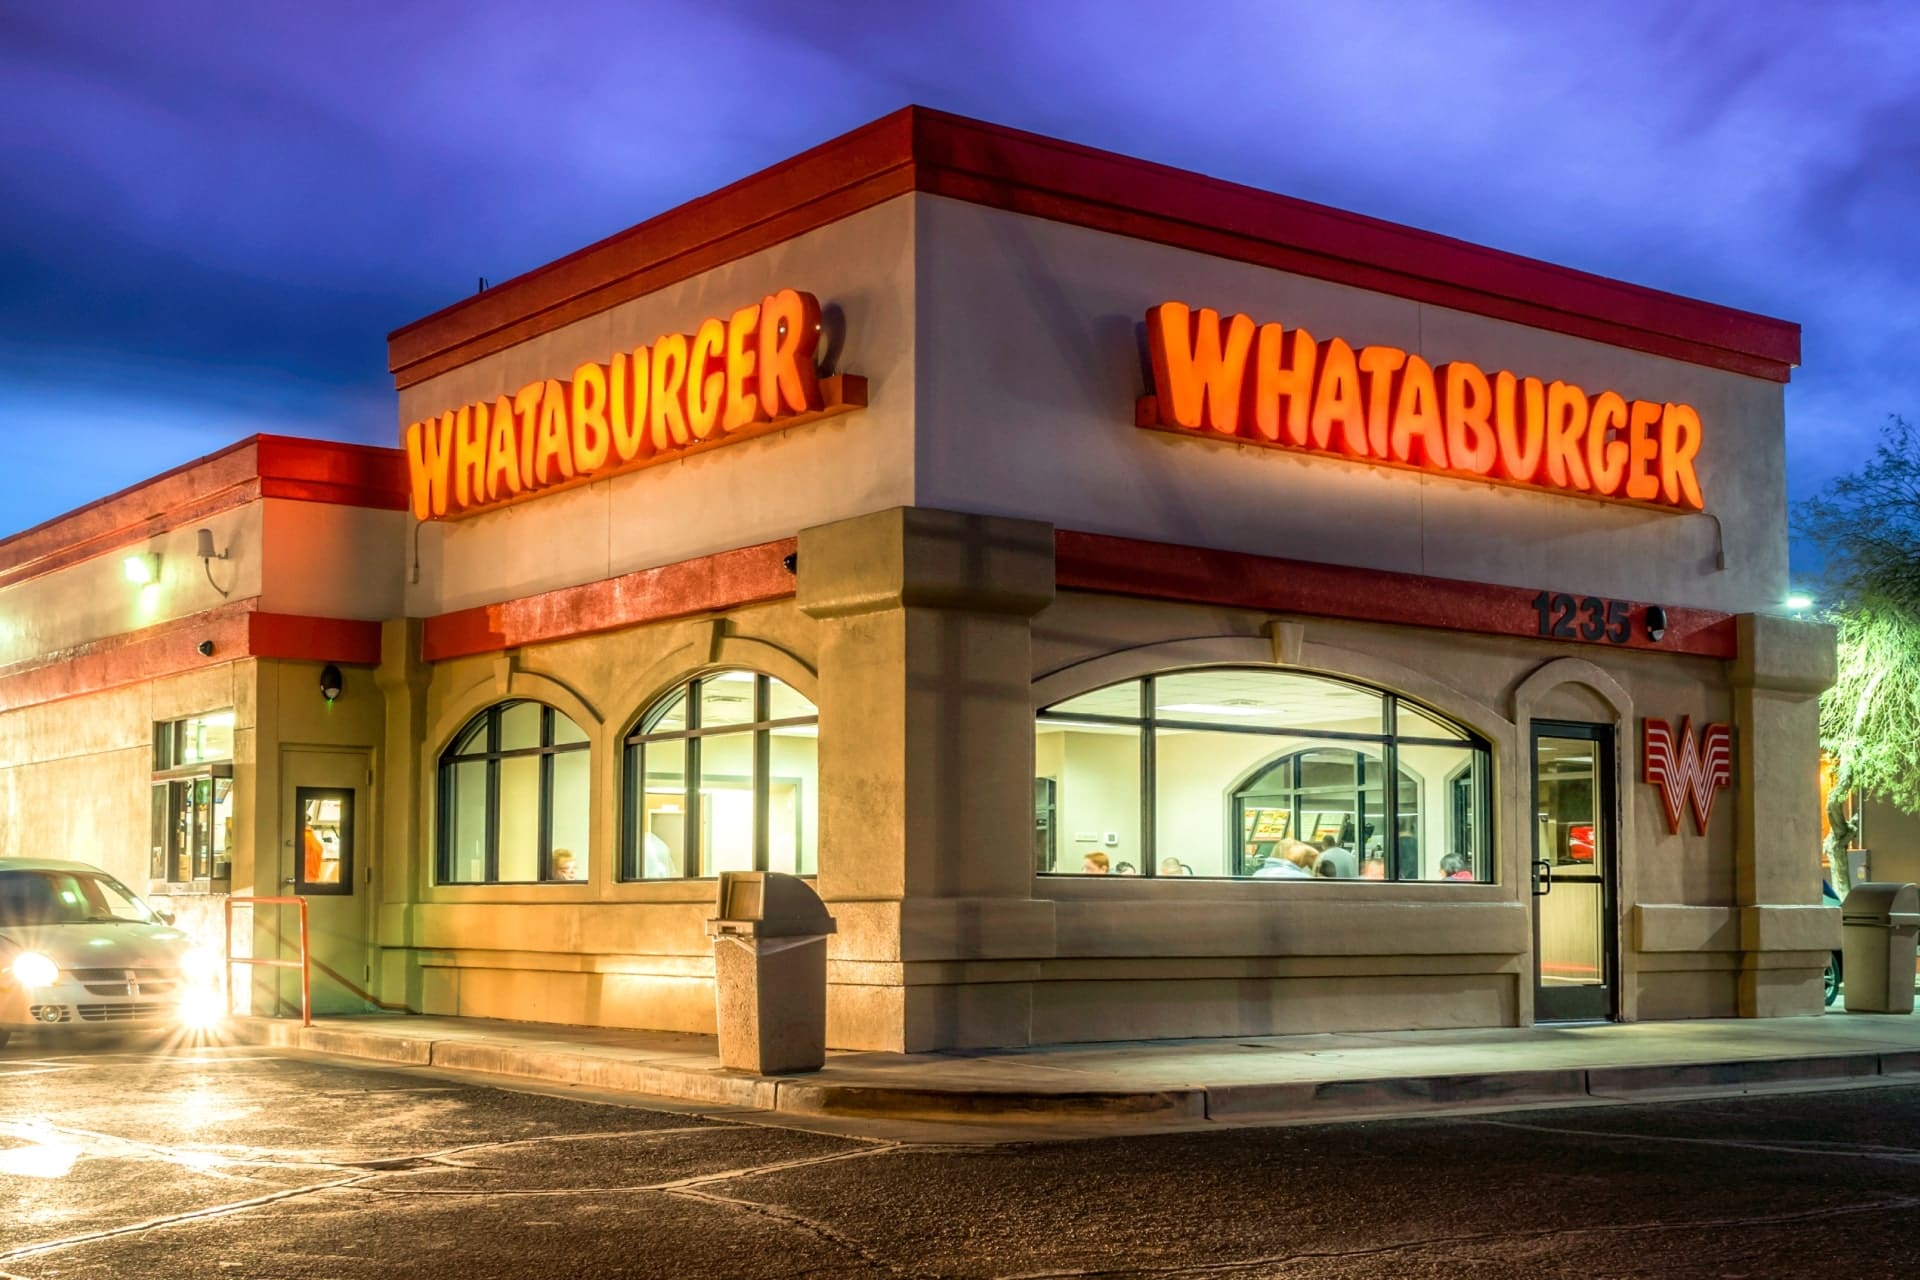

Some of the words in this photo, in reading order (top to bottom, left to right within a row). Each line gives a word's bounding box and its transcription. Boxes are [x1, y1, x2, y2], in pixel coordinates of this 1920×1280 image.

[406, 288, 815, 521] WHATABURGER
[1152, 301, 1704, 510] WHATABURGER
[1533, 591, 1632, 643] 1235
[1642, 714, 1730, 837] W
